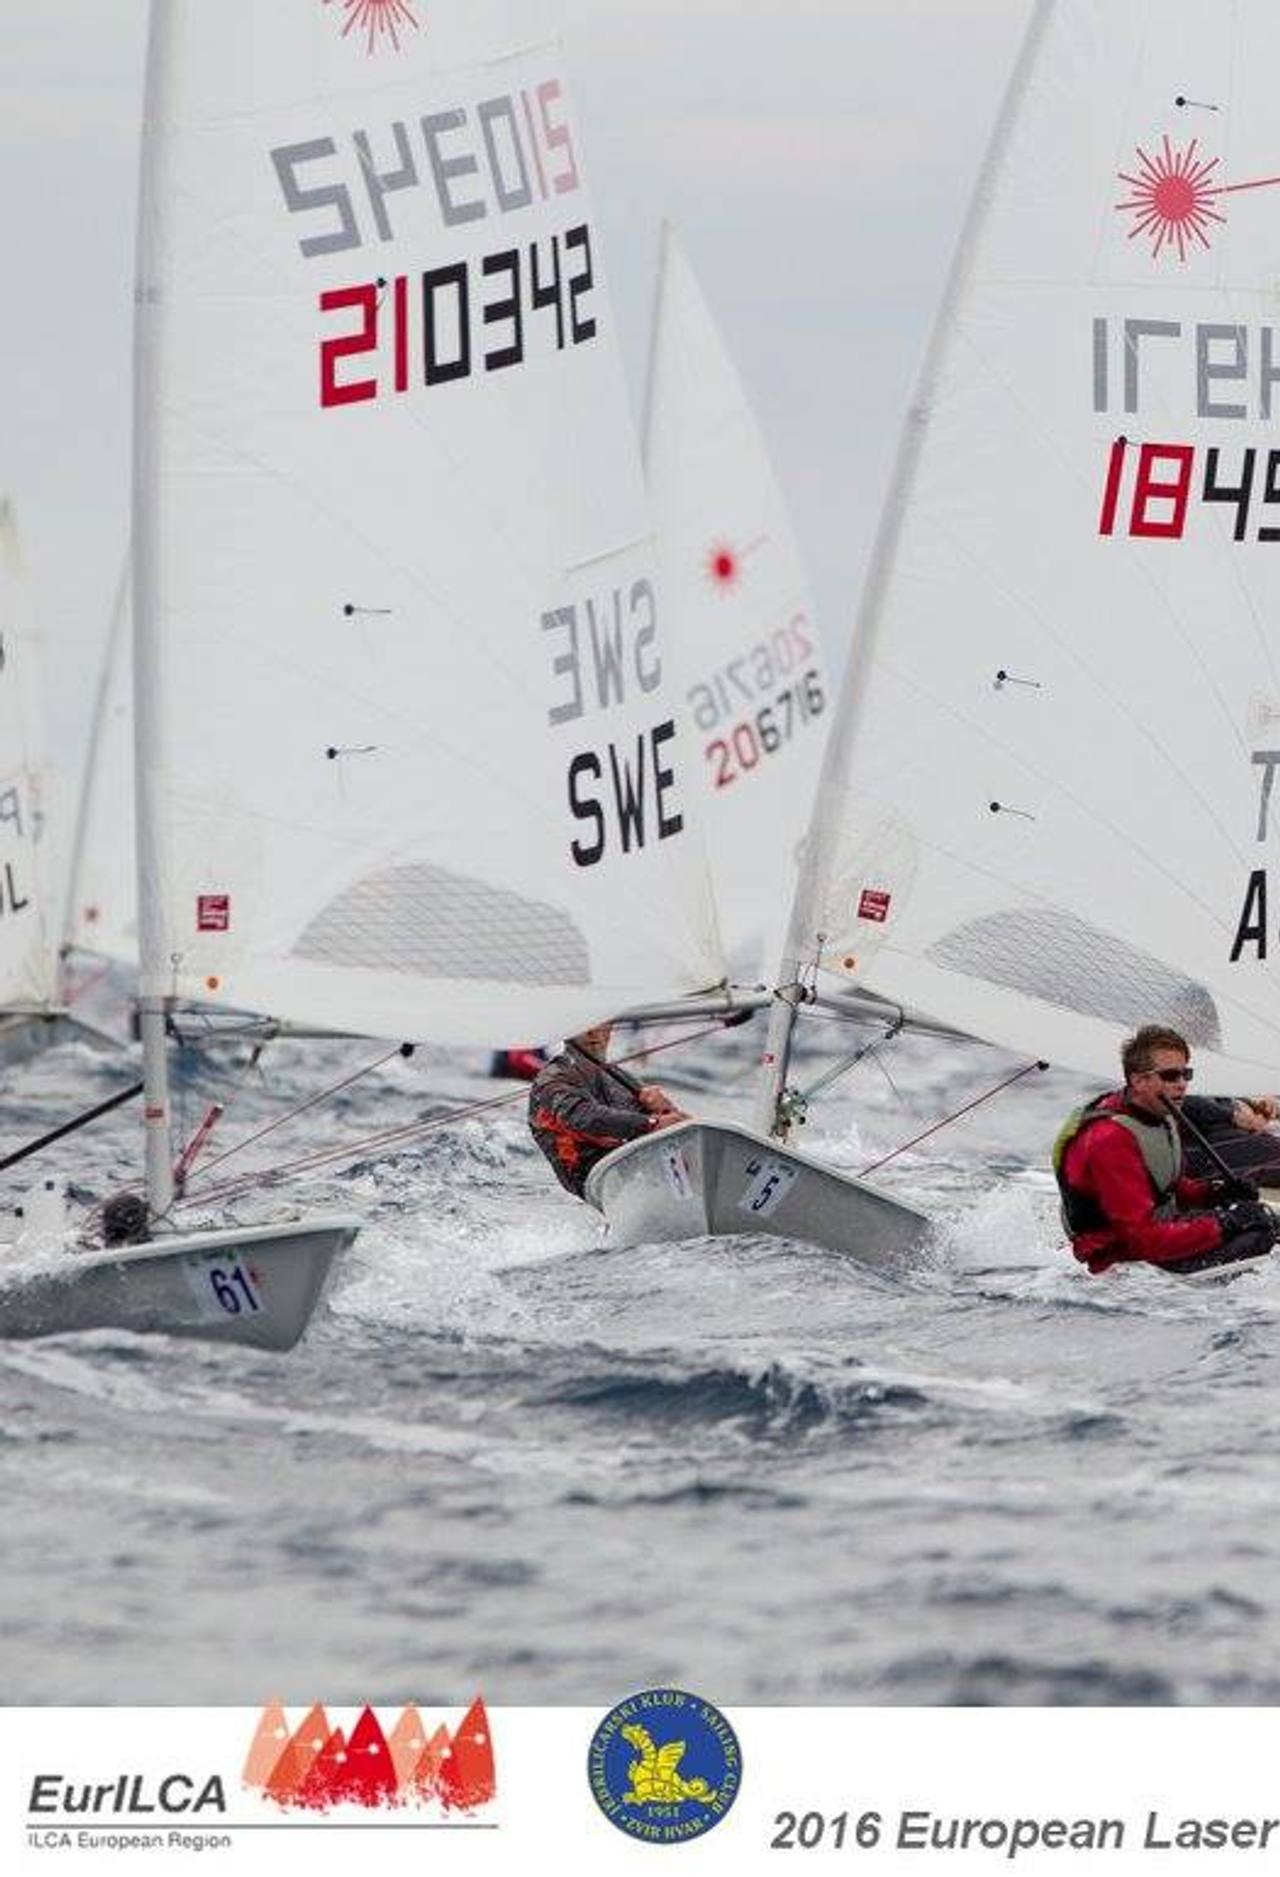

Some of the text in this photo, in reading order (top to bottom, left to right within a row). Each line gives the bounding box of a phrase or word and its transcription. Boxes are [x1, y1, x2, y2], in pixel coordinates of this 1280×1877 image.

[319, 224, 597, 408] 210342
[568, 720, 684, 867] SWE
[705, 670, 825, 788] 206716
[210, 1266, 258, 1315] 61
